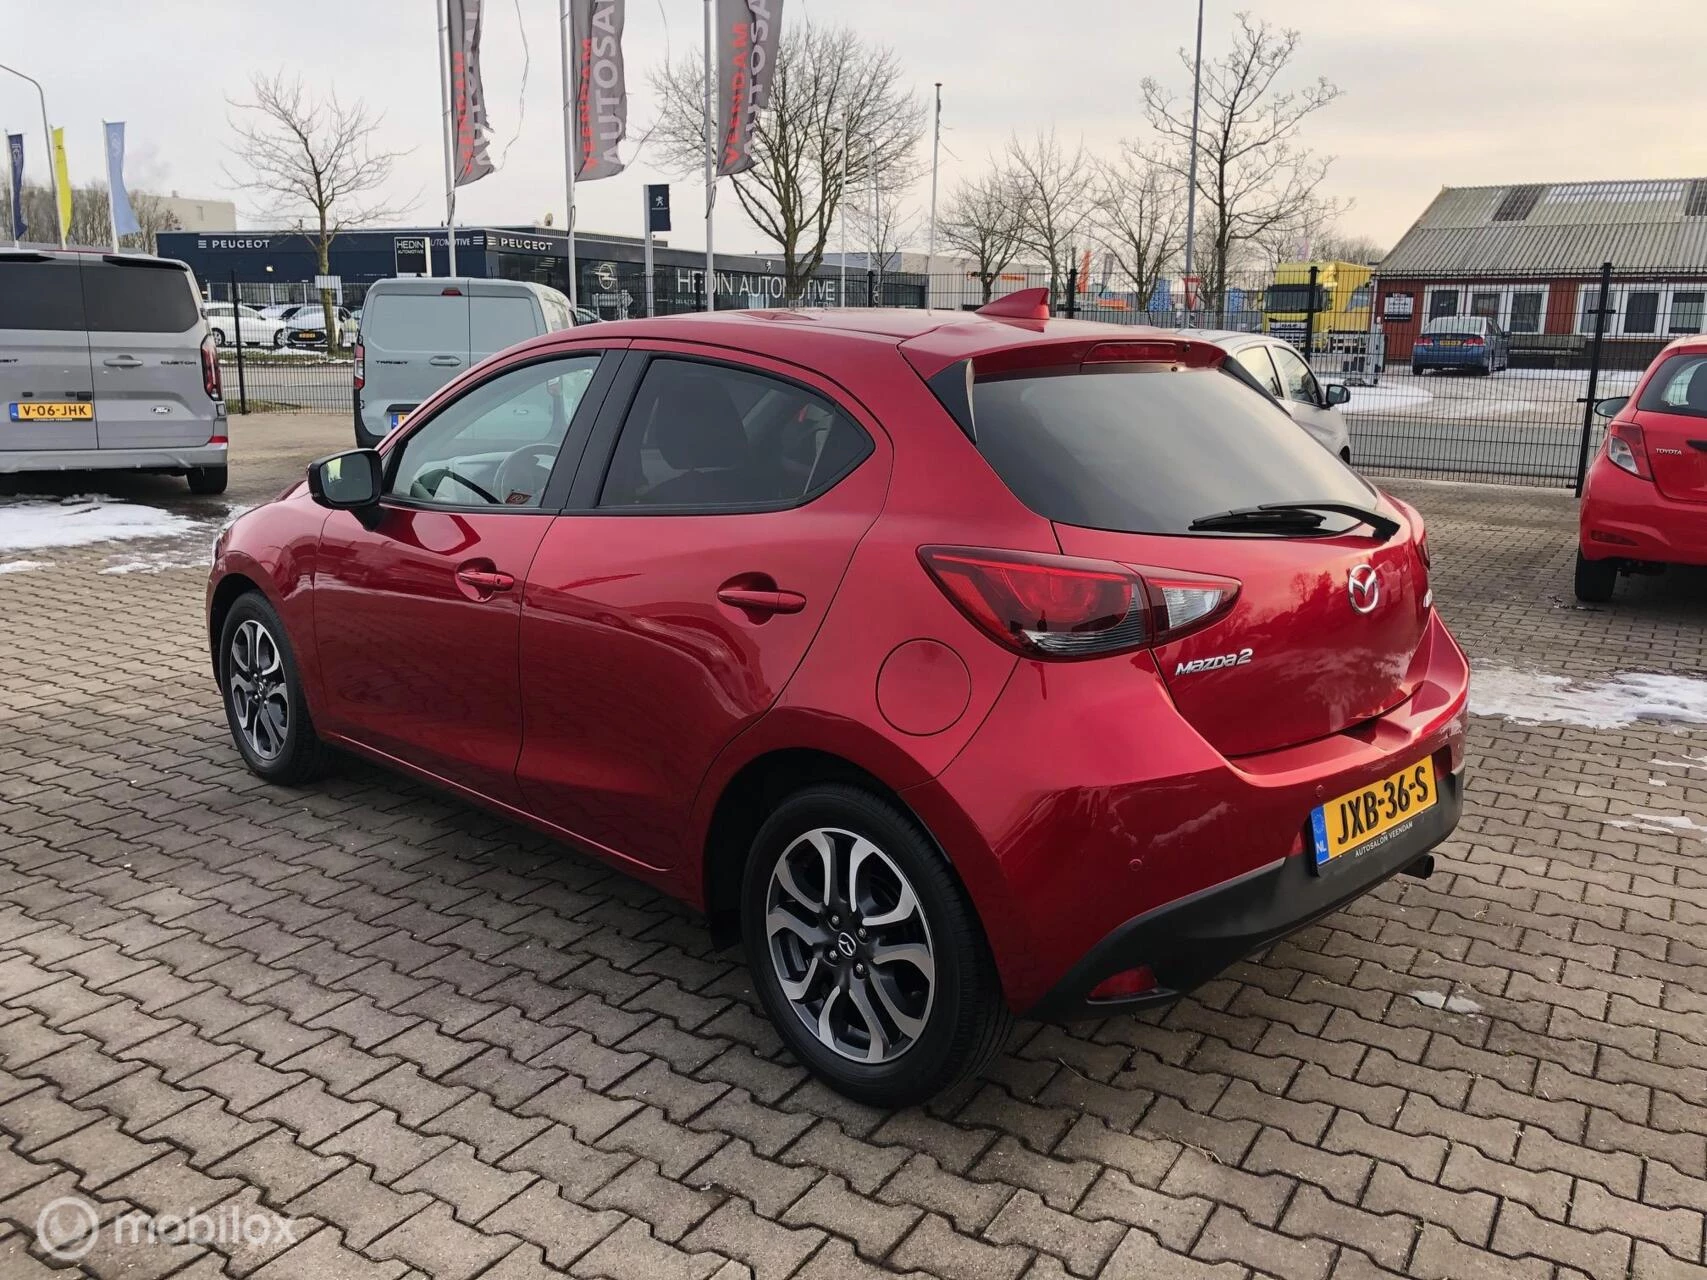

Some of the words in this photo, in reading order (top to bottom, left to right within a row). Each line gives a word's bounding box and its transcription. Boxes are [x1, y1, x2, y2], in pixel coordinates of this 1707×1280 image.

[592, 0, 624, 165] AUTOSA
[724, 23, 749, 165] VEENDAM
[579, 38, 598, 172] VEENDAM
[212, 240, 270, 249] PEUGEOT
[396, 240, 424, 249] HEDIN
[501, 237, 553, 251] PEUGEOT
[677, 268, 733, 296] HEDIN
[739, 274, 835, 301] AUTOTIVE
[22, 405, 87, 417] V-06-JHK
[1656, 447, 1682, 456] TOYOTA
[1338, 766, 1429, 845] JXB-36-S
[1316, 842, 1327, 855] NL
[1355, 834, 1389, 858] AUTOSALON
[1389, 821, 1413, 840] VEENDAM
